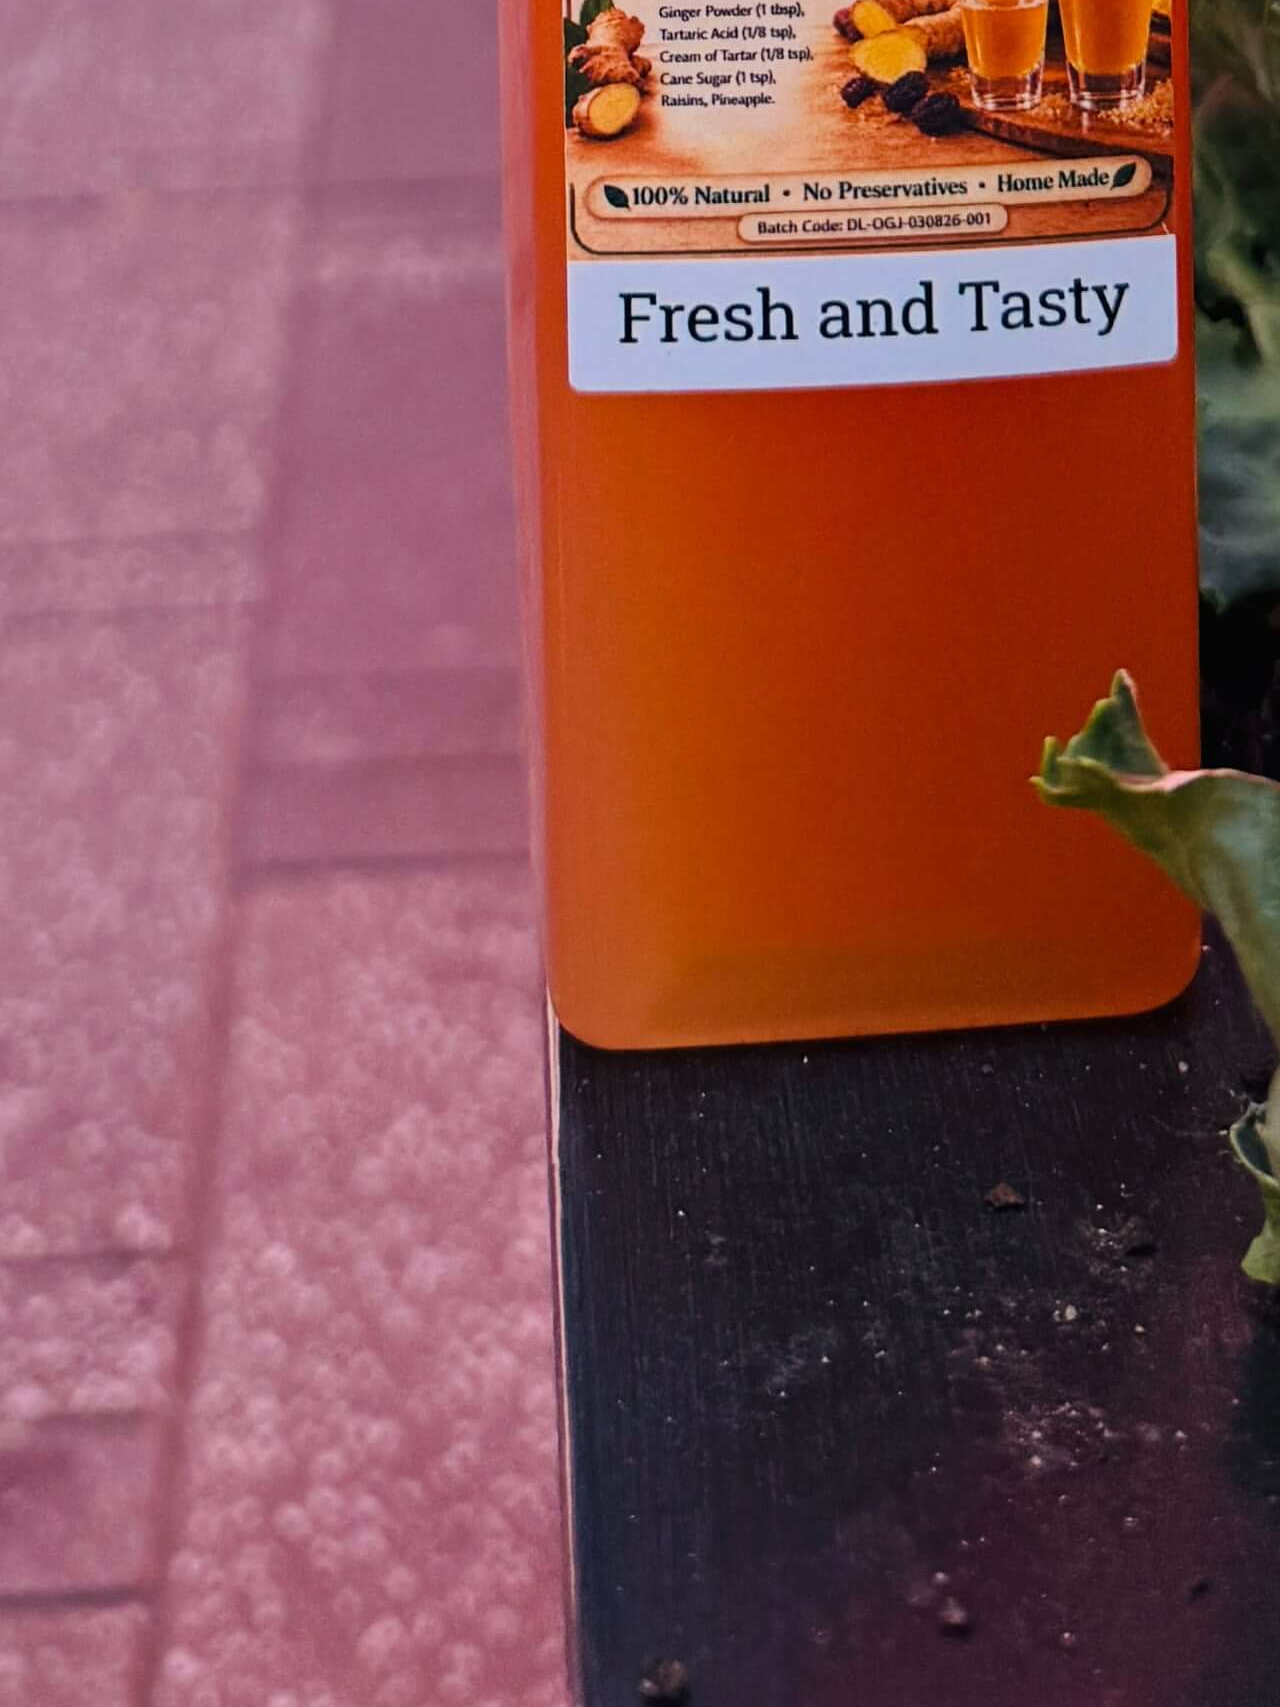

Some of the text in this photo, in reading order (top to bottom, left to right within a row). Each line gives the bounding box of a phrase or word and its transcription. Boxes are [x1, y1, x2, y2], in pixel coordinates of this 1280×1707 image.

[659, 5, 702, 22] Ginger
[705, 4, 752, 18] Powder
[755, 3, 767, 19] (1
[659, 28, 709, 41] Tartaric
[710, 26, 739, 40] Acid
[741, 25, 767, 41] (1/8
[659, 50, 702, 63] Cream
[704, 48, 718, 62] of
[720, 48, 758, 62] Tartar
[760, 47, 785, 63] (1/8
[659, 72, 694, 86] Cane
[696, 71, 732, 88] Sugar
[735, 69, 747, 86] (1
[661, 92, 776, 108] Raisins, Pineapple.
[632, 167, 1111, 205] 100% Natural No Preservatives Home Made
[757, 220, 798, 235] Batch
[801, 218, 844, 234] Code:
[618, 277, 1131, 344] Fresh and Tasty
